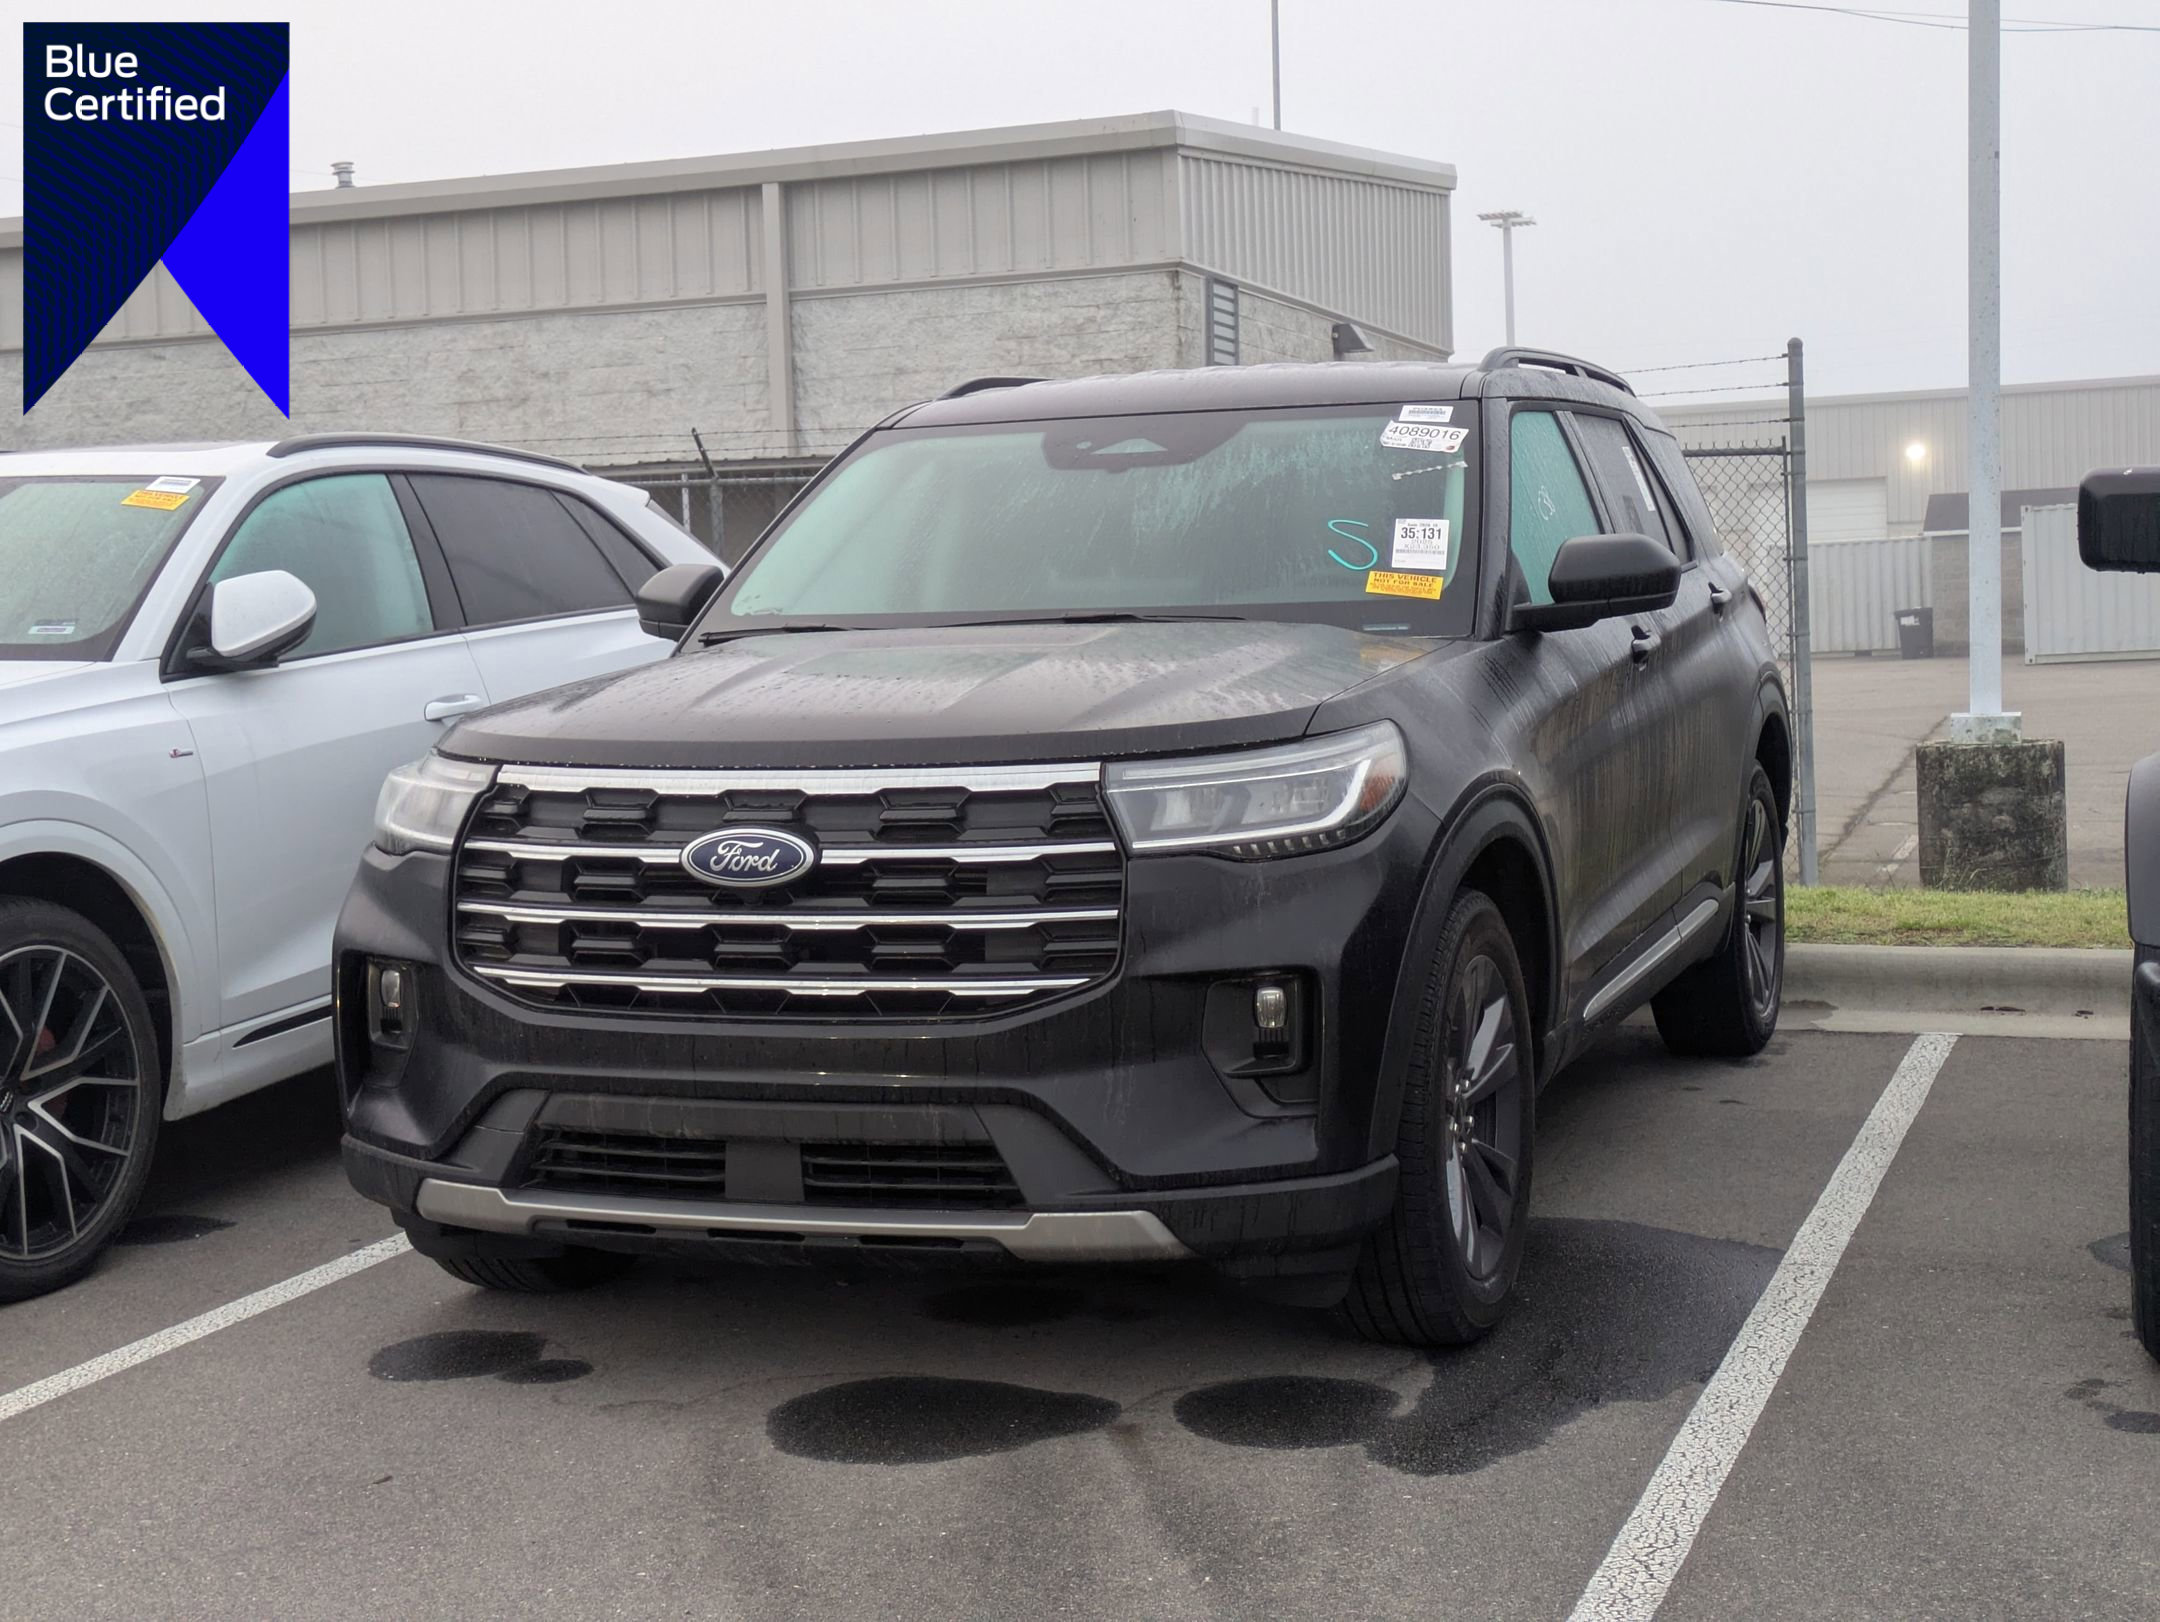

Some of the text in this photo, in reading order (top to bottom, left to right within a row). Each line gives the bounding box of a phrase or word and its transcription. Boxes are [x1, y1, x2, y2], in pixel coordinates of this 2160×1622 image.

[1389, 426, 1461, 441] 4089016
[1401, 527, 1441, 539] 35:131
[1397, 574, 1436, 583] VEHICLE
[710, 840, 780, 871] Ford
